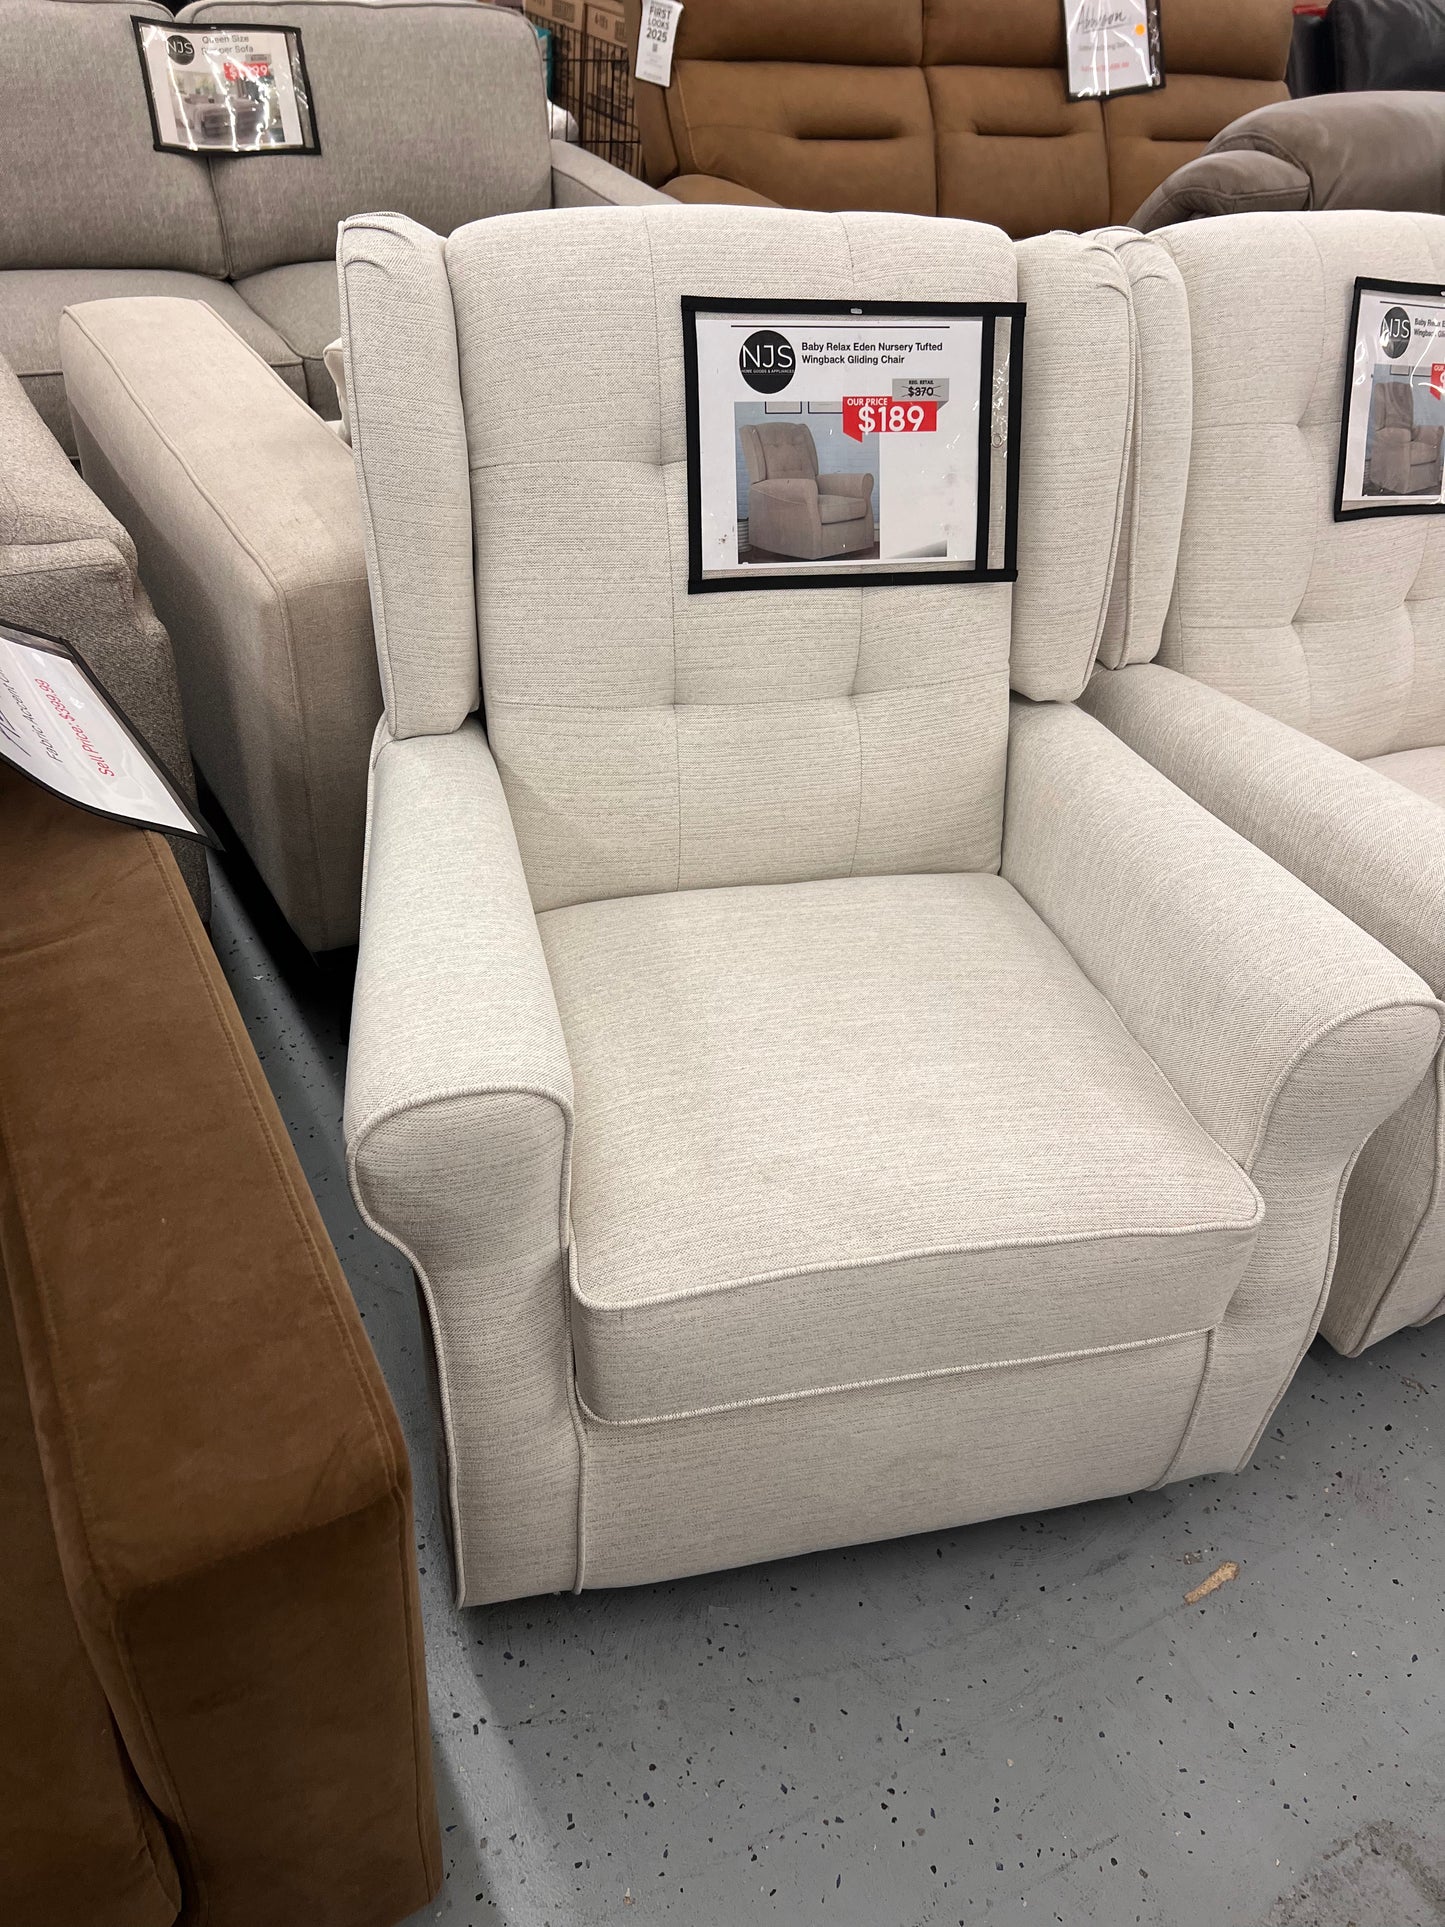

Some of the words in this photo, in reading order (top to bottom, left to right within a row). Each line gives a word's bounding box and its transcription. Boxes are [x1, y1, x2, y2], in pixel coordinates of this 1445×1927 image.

[649, 6, 672, 20] FIRST
[648, 18, 670, 30] LOOKS
[232, 35, 249, 43] Size
[646, 28, 668, 43] 2025
[235, 45, 253, 53] Sofa
[801, 342, 824, 355] Baby
[826, 342, 851, 352] Relax
[853, 342, 876, 352] Eden
[878, 342, 913, 355] Nursery
[915, 342, 943, 352] Tufted
[742, 345, 793, 368] NJS
[801, 354, 845, 367] Wingback
[847, 355, 879, 367] Gliding
[881, 355, 905, 365] Chair
[908, 386, 934, 397] $370
[847, 398, 864, 407] OUR
[866, 397, 888, 407] PRICE
[858, 402, 925, 435] $189
[32, 723, 63, 763] Fabric
[69, 722, 99, 755] Price:
[89, 755, 115, 777] Sell
